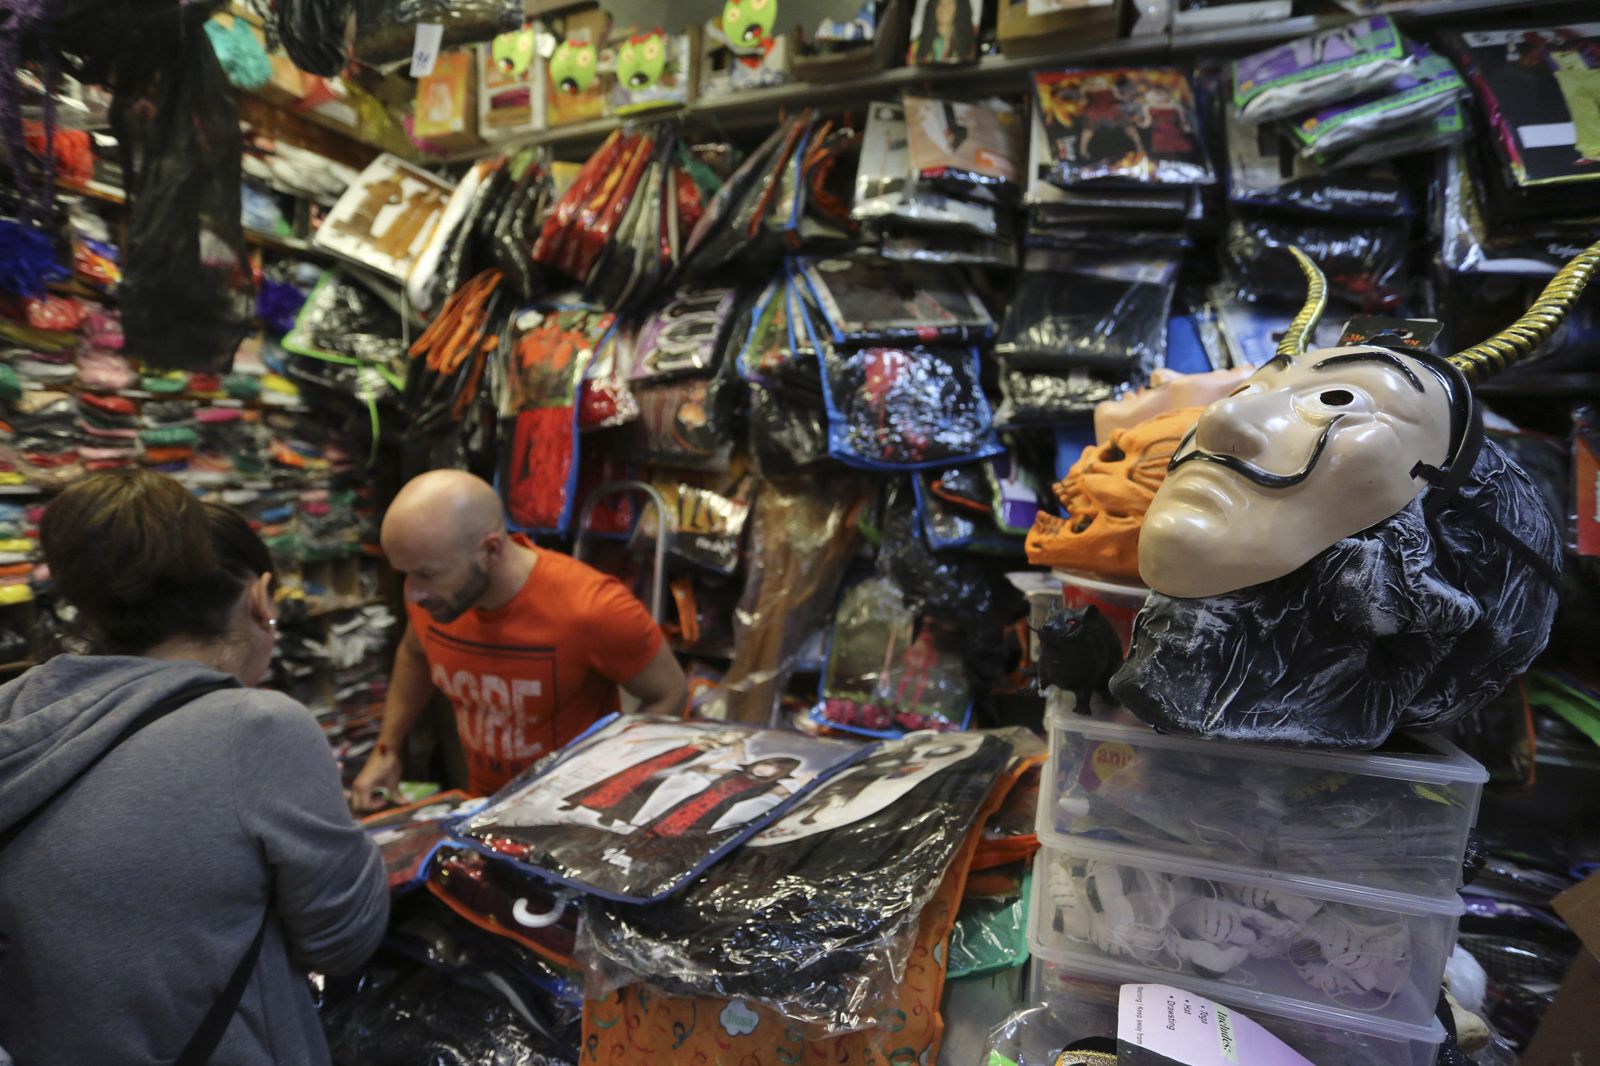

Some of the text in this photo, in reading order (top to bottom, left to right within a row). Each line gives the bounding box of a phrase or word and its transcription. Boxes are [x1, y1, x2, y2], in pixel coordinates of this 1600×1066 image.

[1183, 1003, 1192, 1015] Hat
[1198, 1010, 1209, 1025] Toga
[1135, 1019, 1143, 1032] away
[1216, 1010, 1233, 1053] Includes:
[1136, 1033, 1144, 1045] from
